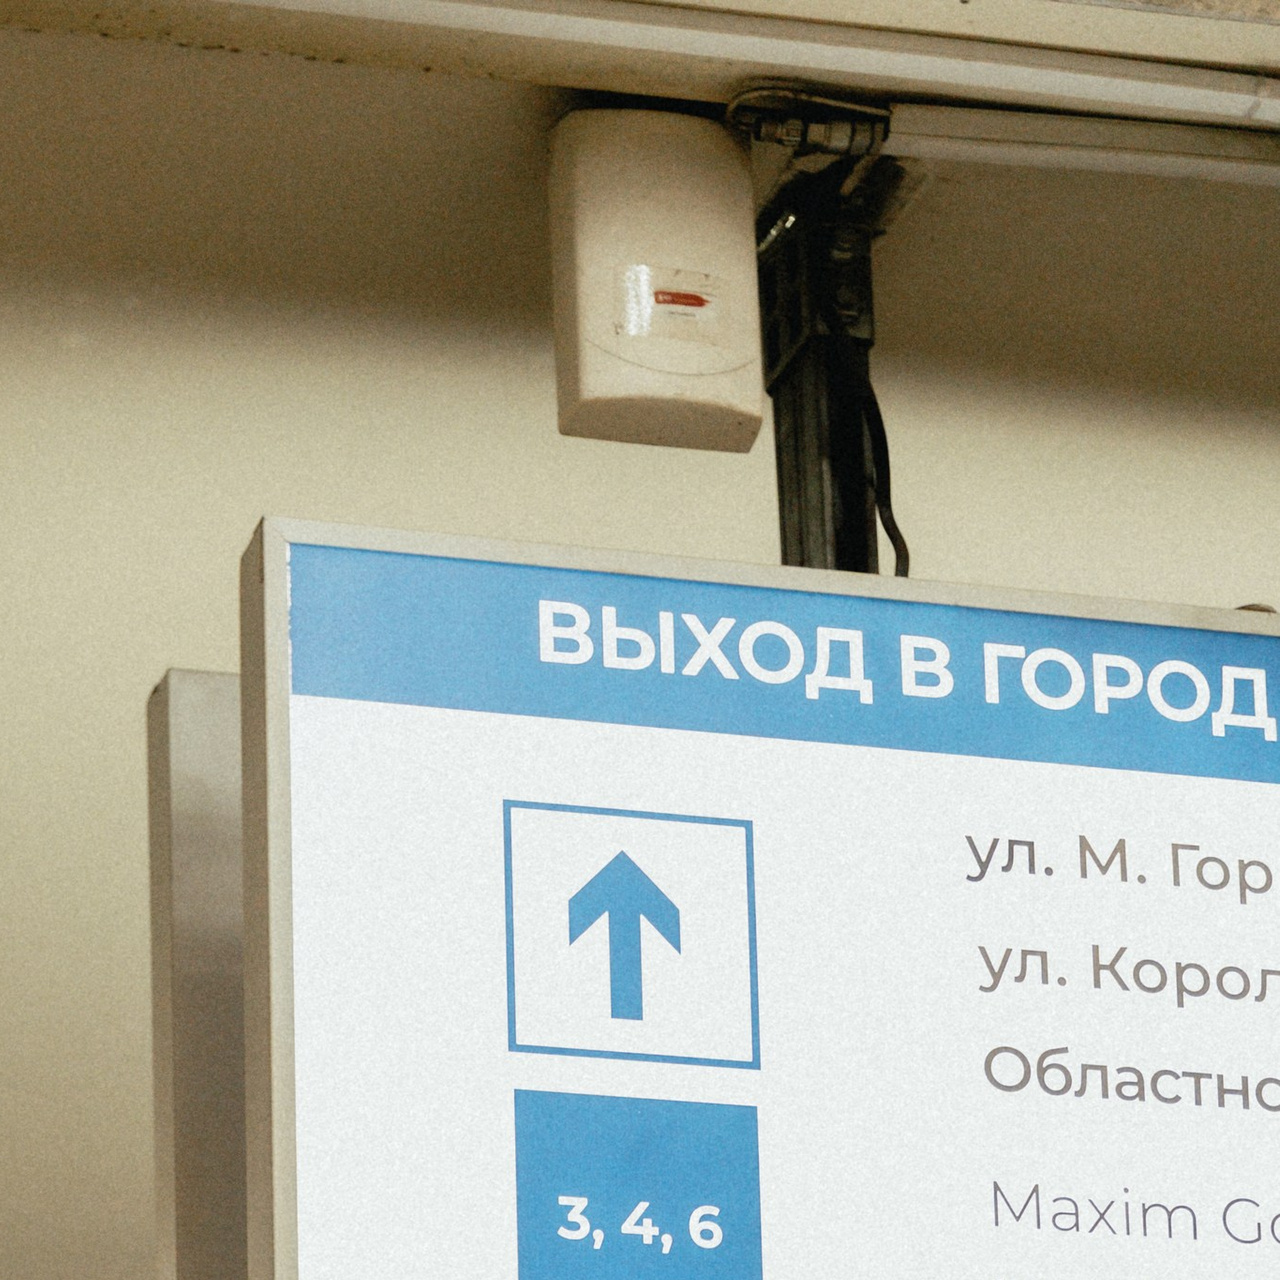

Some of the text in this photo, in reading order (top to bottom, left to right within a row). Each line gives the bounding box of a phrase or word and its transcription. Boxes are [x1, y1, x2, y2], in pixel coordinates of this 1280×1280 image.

[538, 599, 1278, 742] ВЫХОД В ГОРОД
[965, 834, 1273, 905] ул. М. Гор
[977, 944, 1280, 1008] ул. Корол
[983, 1045, 1280, 1113] Областно
[557, 1195, 723, 1254] 3, 4, 6
[992, 1180, 1280, 1245] Maxim G
